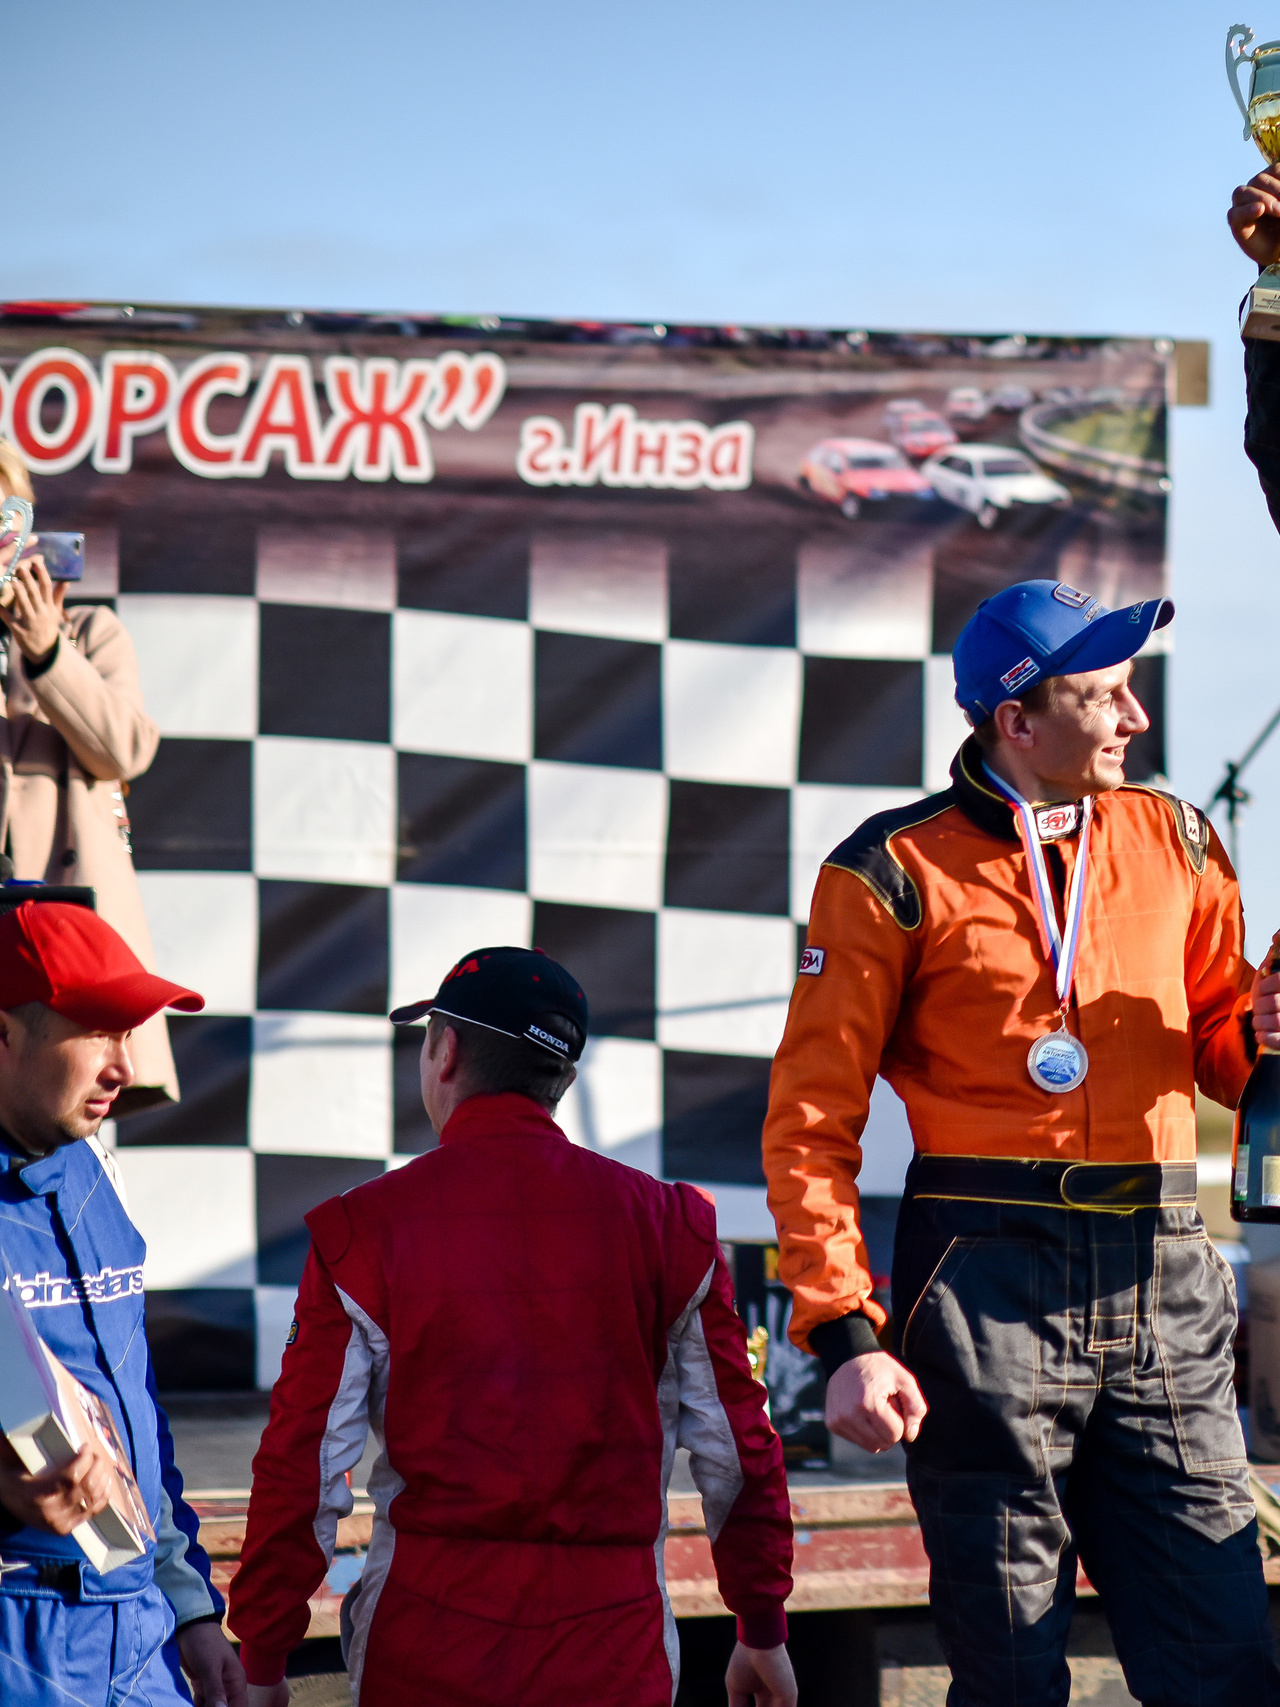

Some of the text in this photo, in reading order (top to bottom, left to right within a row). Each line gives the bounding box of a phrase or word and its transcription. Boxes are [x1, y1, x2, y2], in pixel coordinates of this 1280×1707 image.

[0, 347, 755, 490] ОРСАЖ” г.Инза
[529, 1024, 569, 1053] HONDA
